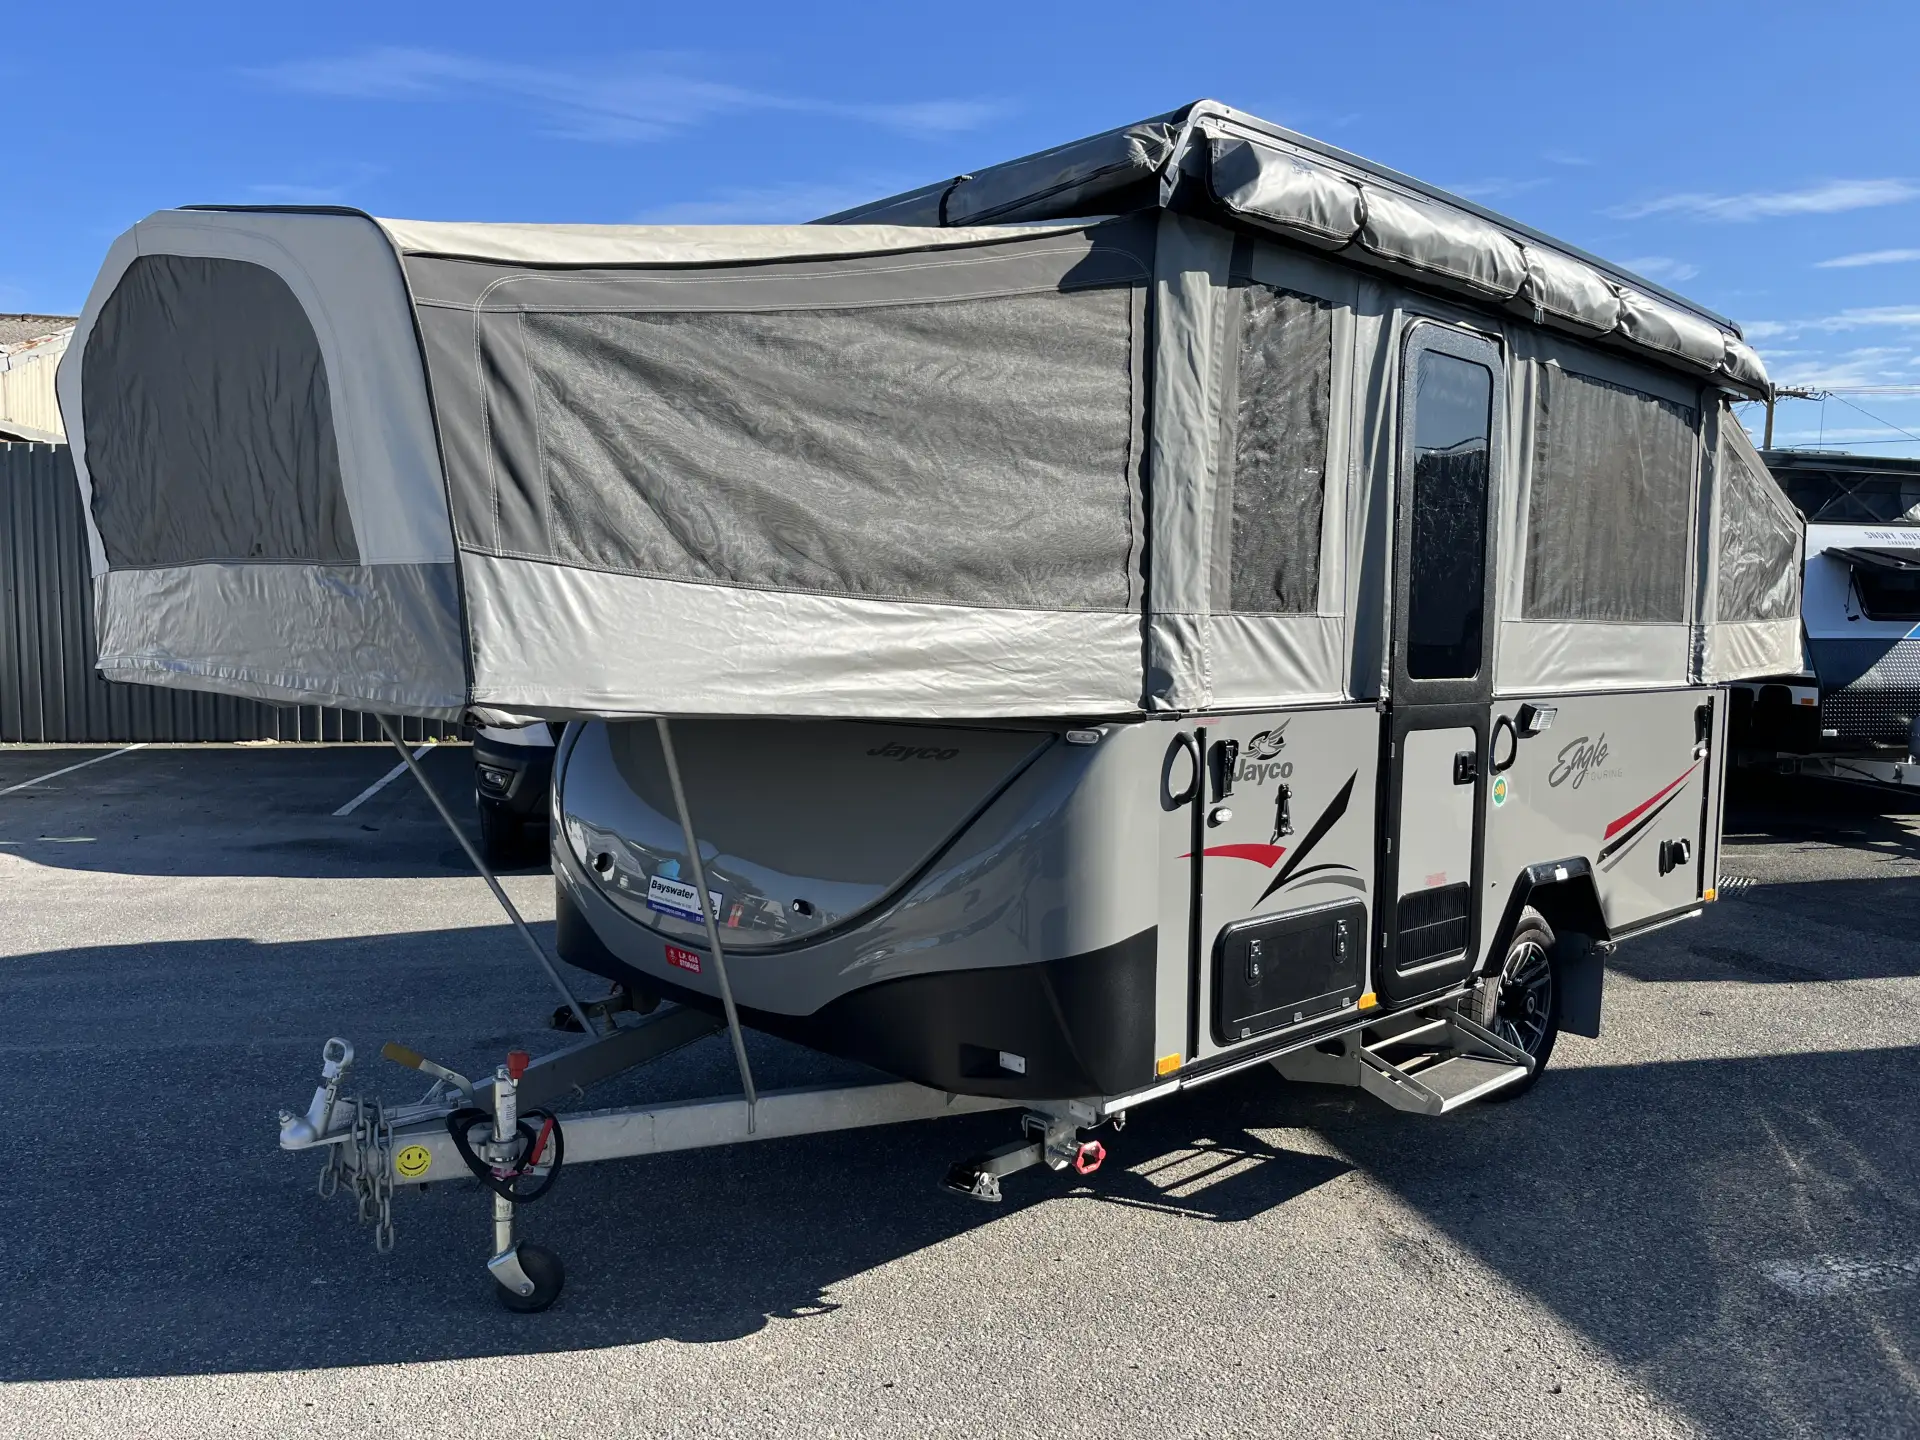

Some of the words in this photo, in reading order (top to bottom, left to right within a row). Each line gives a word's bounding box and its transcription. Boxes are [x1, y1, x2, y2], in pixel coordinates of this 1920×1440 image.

[1864, 532, 1896, 540] SNOWY
[1900, 532, 1920, 540] RIVE
[866, 741, 960, 762] Jayco
[1548, 732, 1609, 790] Eagle
[1232, 759, 1294, 786] Jayco
[1585, 768, 1623, 781] TOURING
[651, 880, 694, 899] Bayswater
